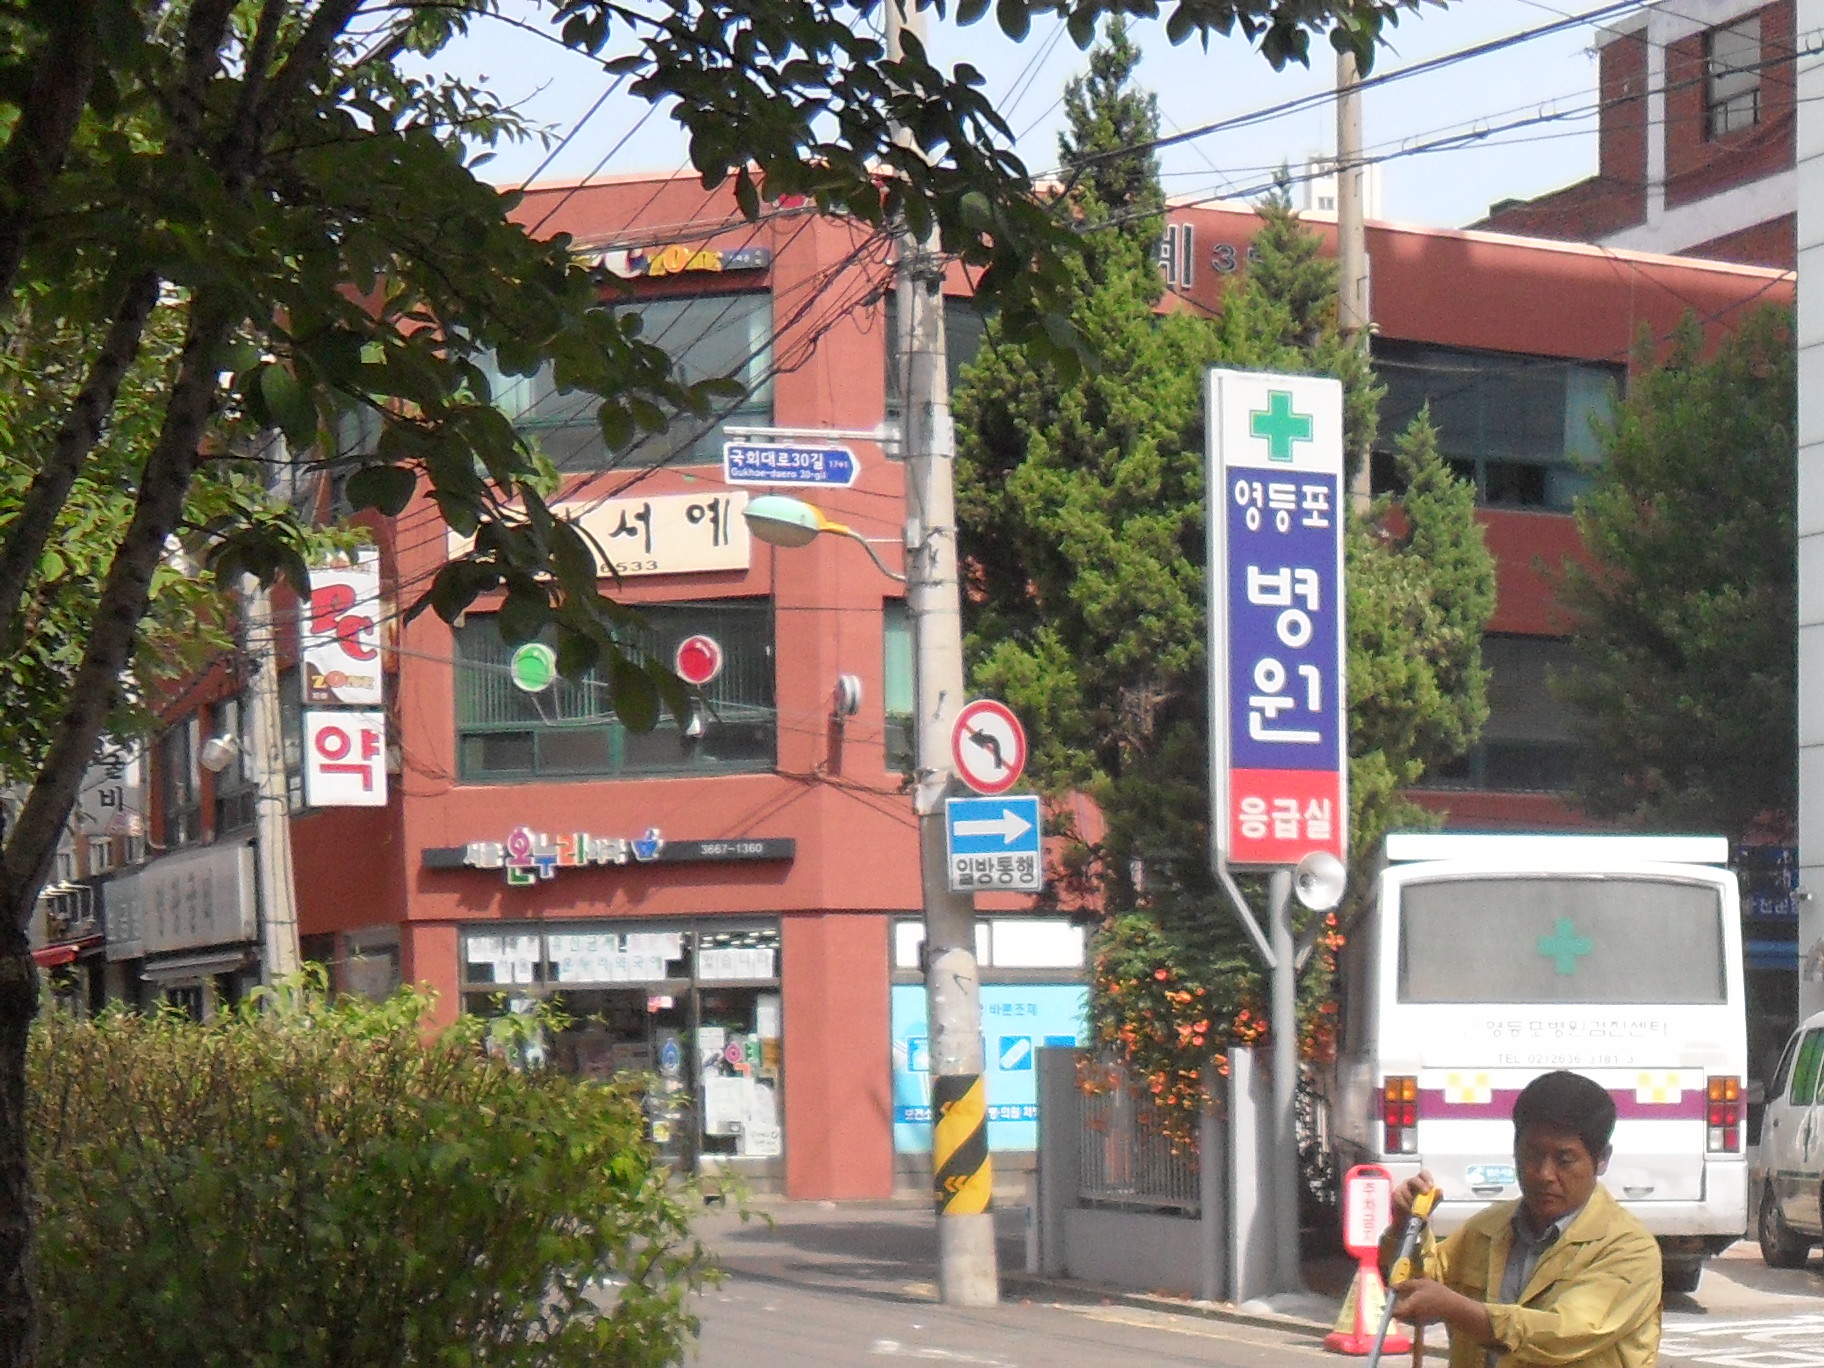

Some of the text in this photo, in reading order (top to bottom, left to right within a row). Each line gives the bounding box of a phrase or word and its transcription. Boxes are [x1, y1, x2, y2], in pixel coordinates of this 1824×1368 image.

[729, 449, 825, 471] 국회대로30길
[1234, 478, 1330, 533] 영등포
[1246, 565, 1321, 743] 병원
[314, 725, 381, 792] 약
[1238, 797, 1332, 840] 응급실
[956, 855, 1035, 886] 일방통행
[1498, 1053, 1520, 1064] TEL
